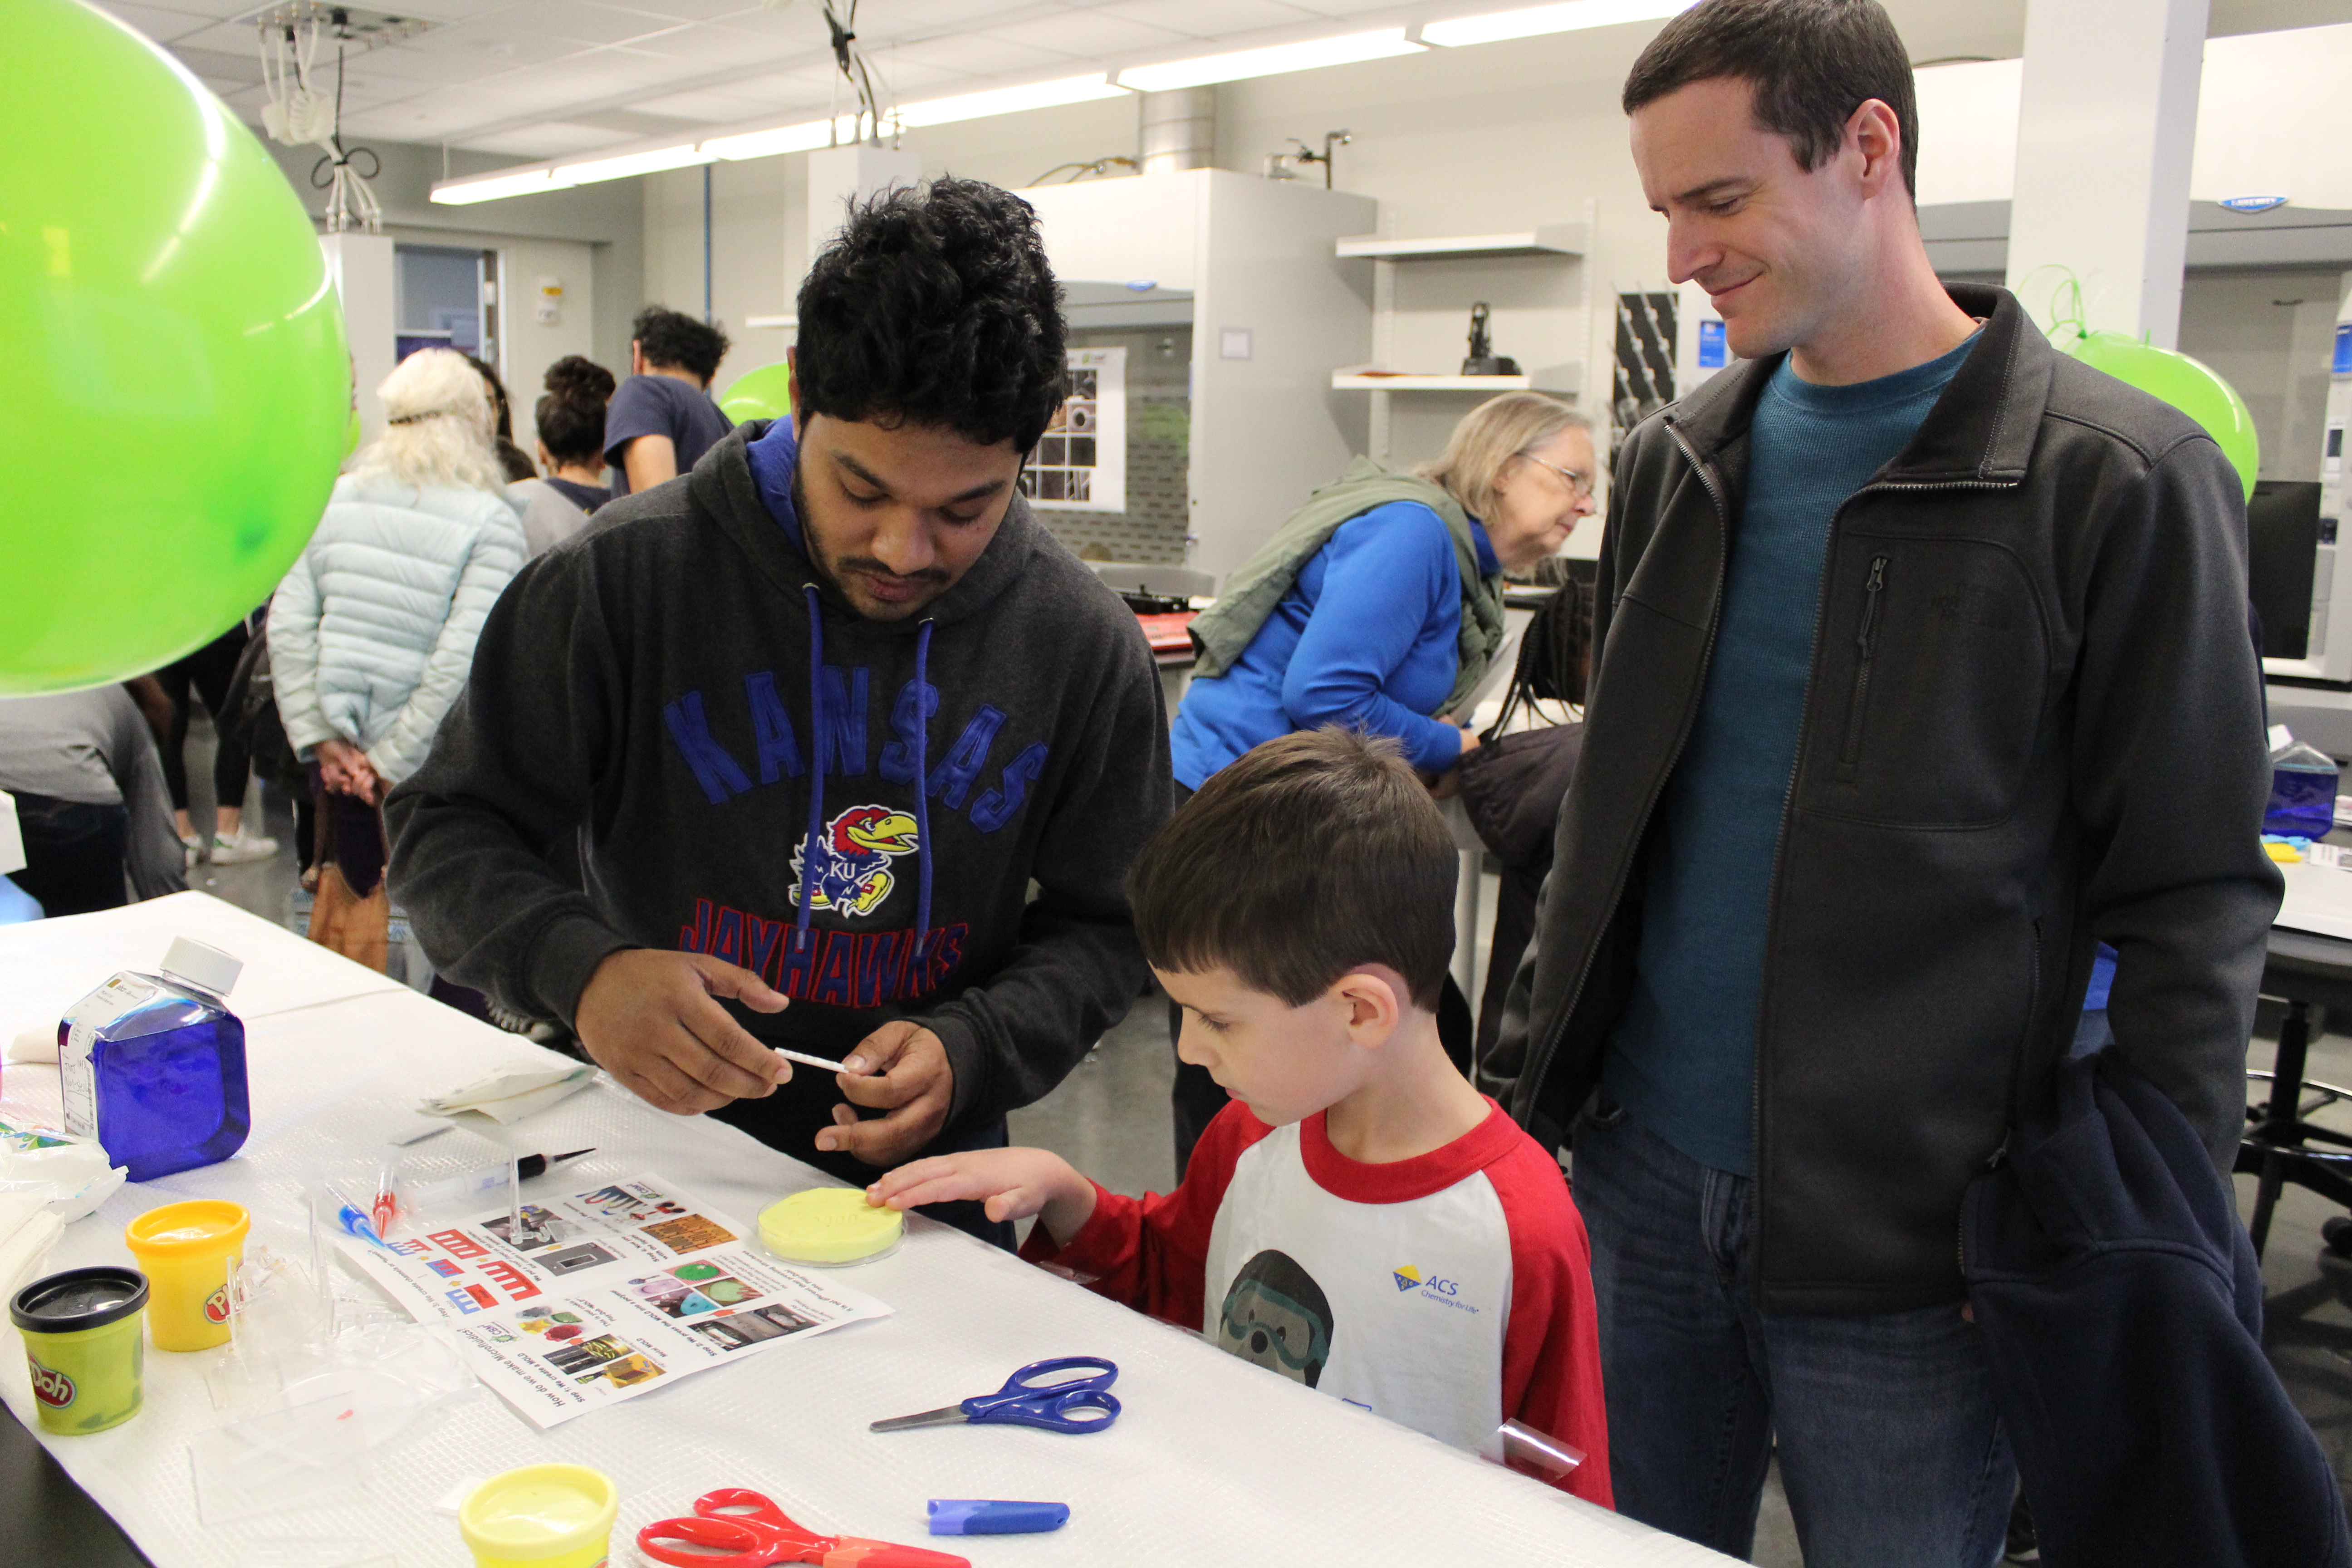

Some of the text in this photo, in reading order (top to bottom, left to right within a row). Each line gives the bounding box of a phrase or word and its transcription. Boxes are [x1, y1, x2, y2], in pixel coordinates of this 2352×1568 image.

[663, 666, 1048, 834] KANSAS
[829, 861, 857, 882] KU
[679, 898, 969, 1009] JAYHAWKS
[1426, 1275, 1459, 1296] ACS
[1421, 1289, 1455, 1307] Chemistry
[1455, 1301, 1466, 1310] for
[644, 1311, 662, 1321] MOLD
[671, 1327, 689, 1337] press
[456, 1328, 506, 1362] Microfluidics?
[636, 1338, 667, 1357] Metal MOLD
[702, 1347, 717, 1357] Step
[517, 1352, 536, 1365] MOLD
[504, 1360, 526, 1376] make
[538, 1367, 557, 1381] create
[523, 1375, 537, 1385] we
[545, 1393, 566, 1407] How
[570, 1392, 585, 1403] Step
